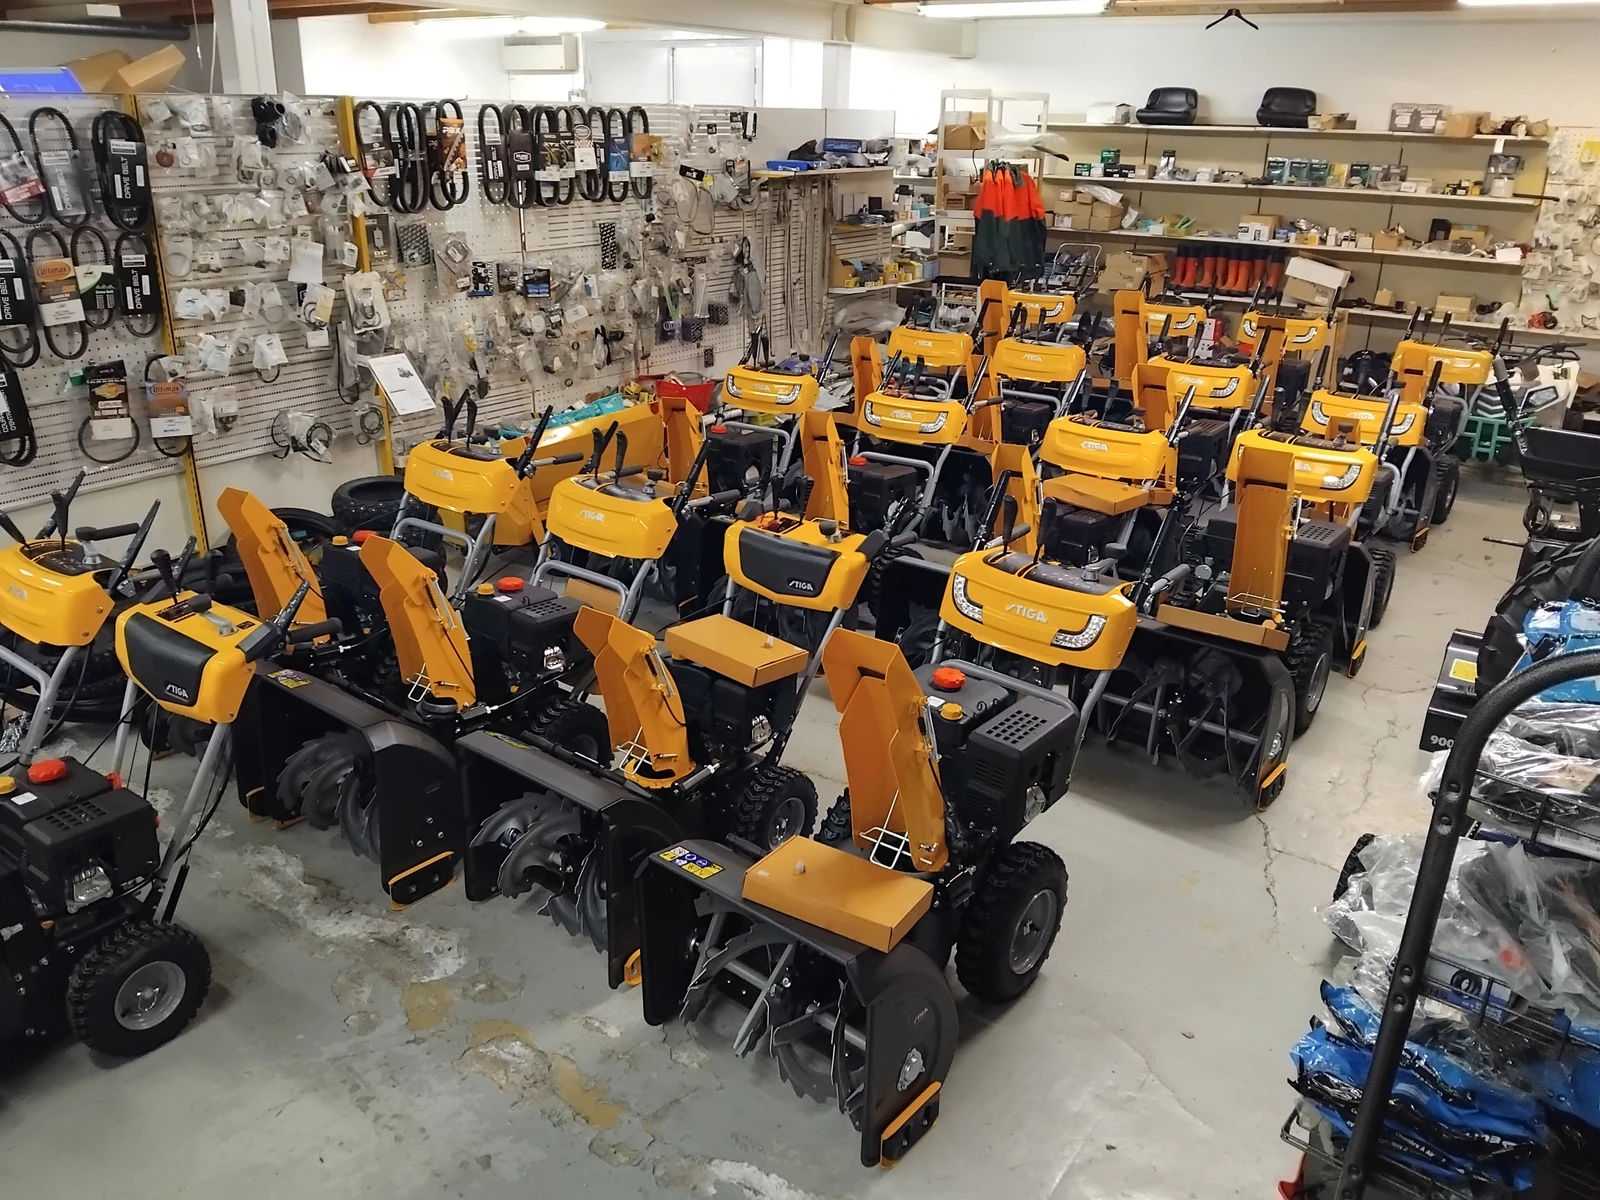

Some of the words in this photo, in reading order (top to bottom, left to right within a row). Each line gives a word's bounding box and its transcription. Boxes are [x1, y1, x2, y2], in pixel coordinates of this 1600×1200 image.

[120, 156, 129, 175] BELT
[122, 176, 131, 199] DRIVE
[61, 188, 72, 210] DRIVE
[40, 267, 67, 276] Ultimax
[131, 269, 139, 287] BELT
[133, 288, 142, 309] DRIVE
[2, 296, 12, 320] DRIVE
[914, 340, 932, 348] STIGA
[1022, 354, 1043, 362] STIGA
[752, 384, 770, 392] STIGA
[890, 411, 912, 421] STIGA
[1081, 441, 1108, 451] STIGA
[578, 510, 604, 522] STIGA
[789, 580, 813, 591] STIGA
[1005, 603, 1047, 624] STIGA
[166, 684, 189, 699] STIGA
